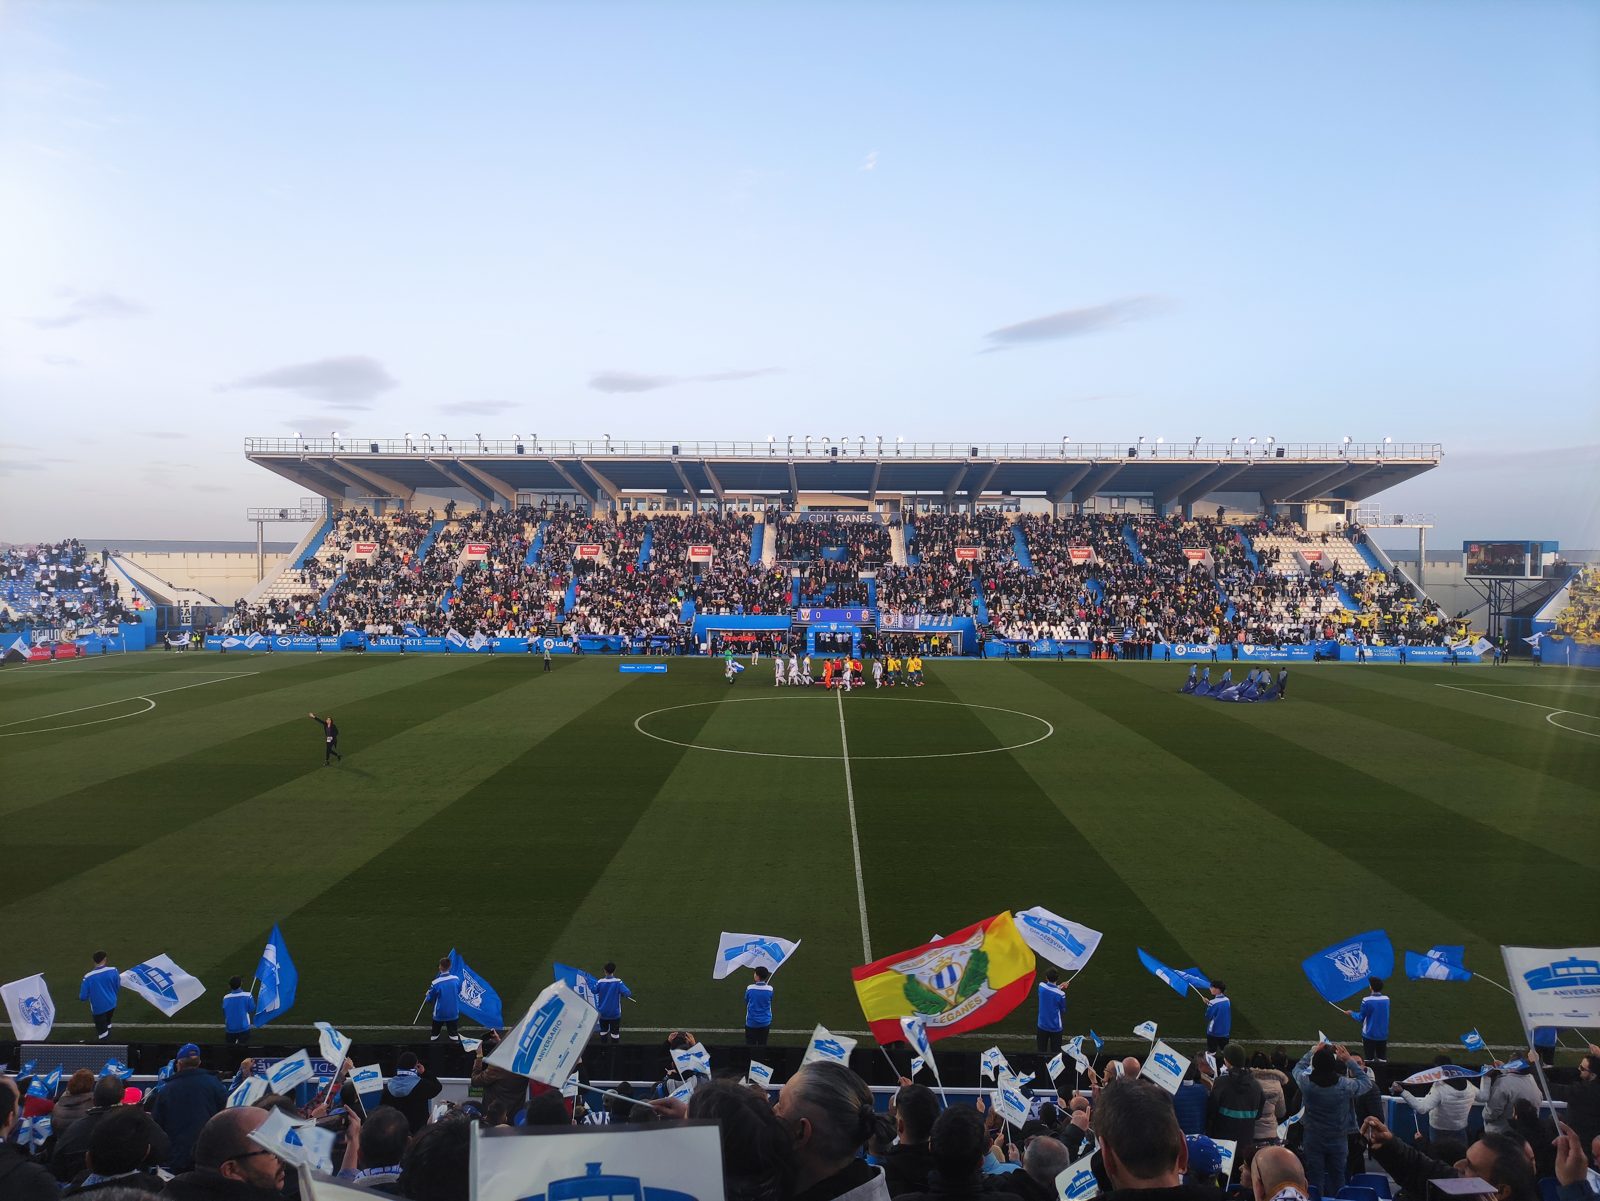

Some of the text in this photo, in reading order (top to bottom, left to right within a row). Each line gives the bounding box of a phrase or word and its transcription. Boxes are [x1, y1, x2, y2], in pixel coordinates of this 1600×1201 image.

[816, 611, 821, 619] 0
[846, 611, 852, 619] 0
[537, 1019, 562, 1062] ANIVERSARIO
